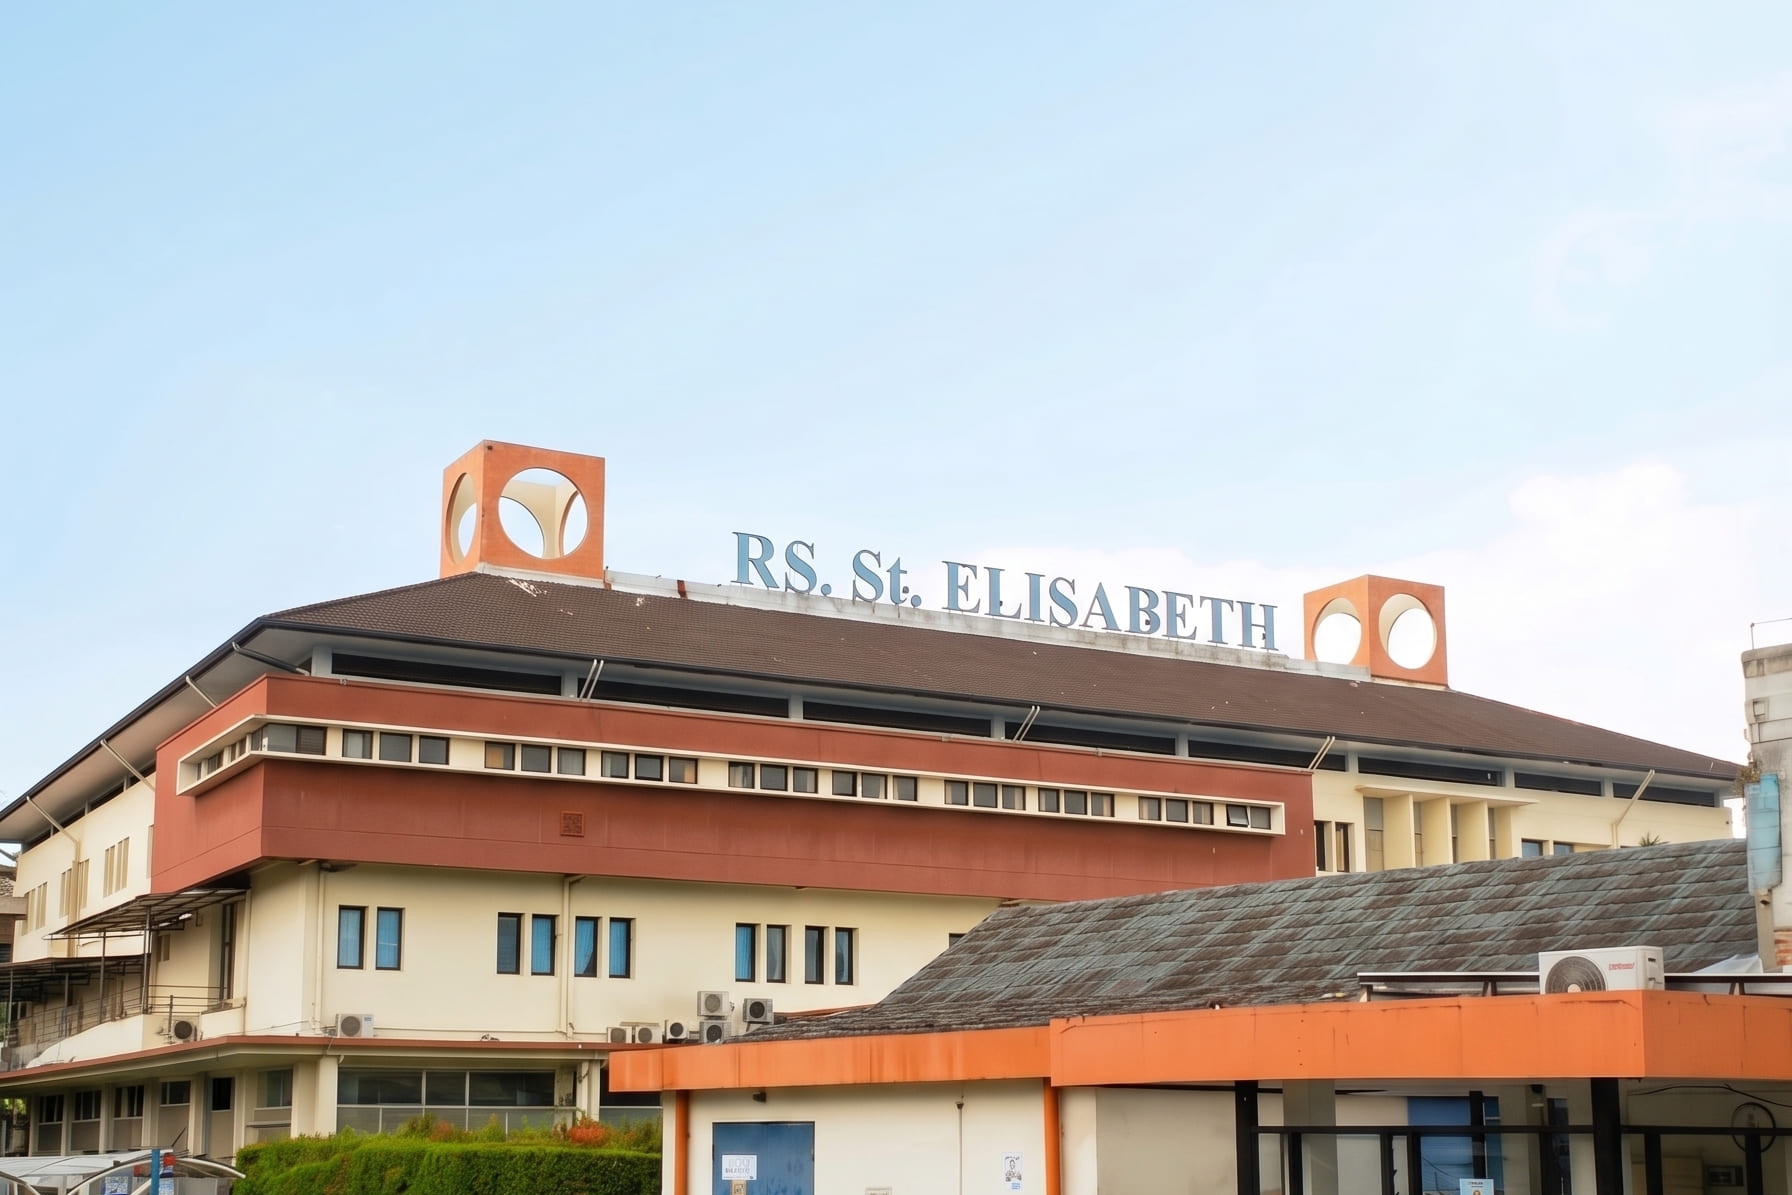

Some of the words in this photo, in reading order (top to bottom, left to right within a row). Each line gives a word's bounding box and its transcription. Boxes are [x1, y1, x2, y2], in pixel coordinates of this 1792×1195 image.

[730, 531, 832, 597] RS.
[852, 549, 922, 608] St.
[942, 561, 1279, 651] ELISABETH
